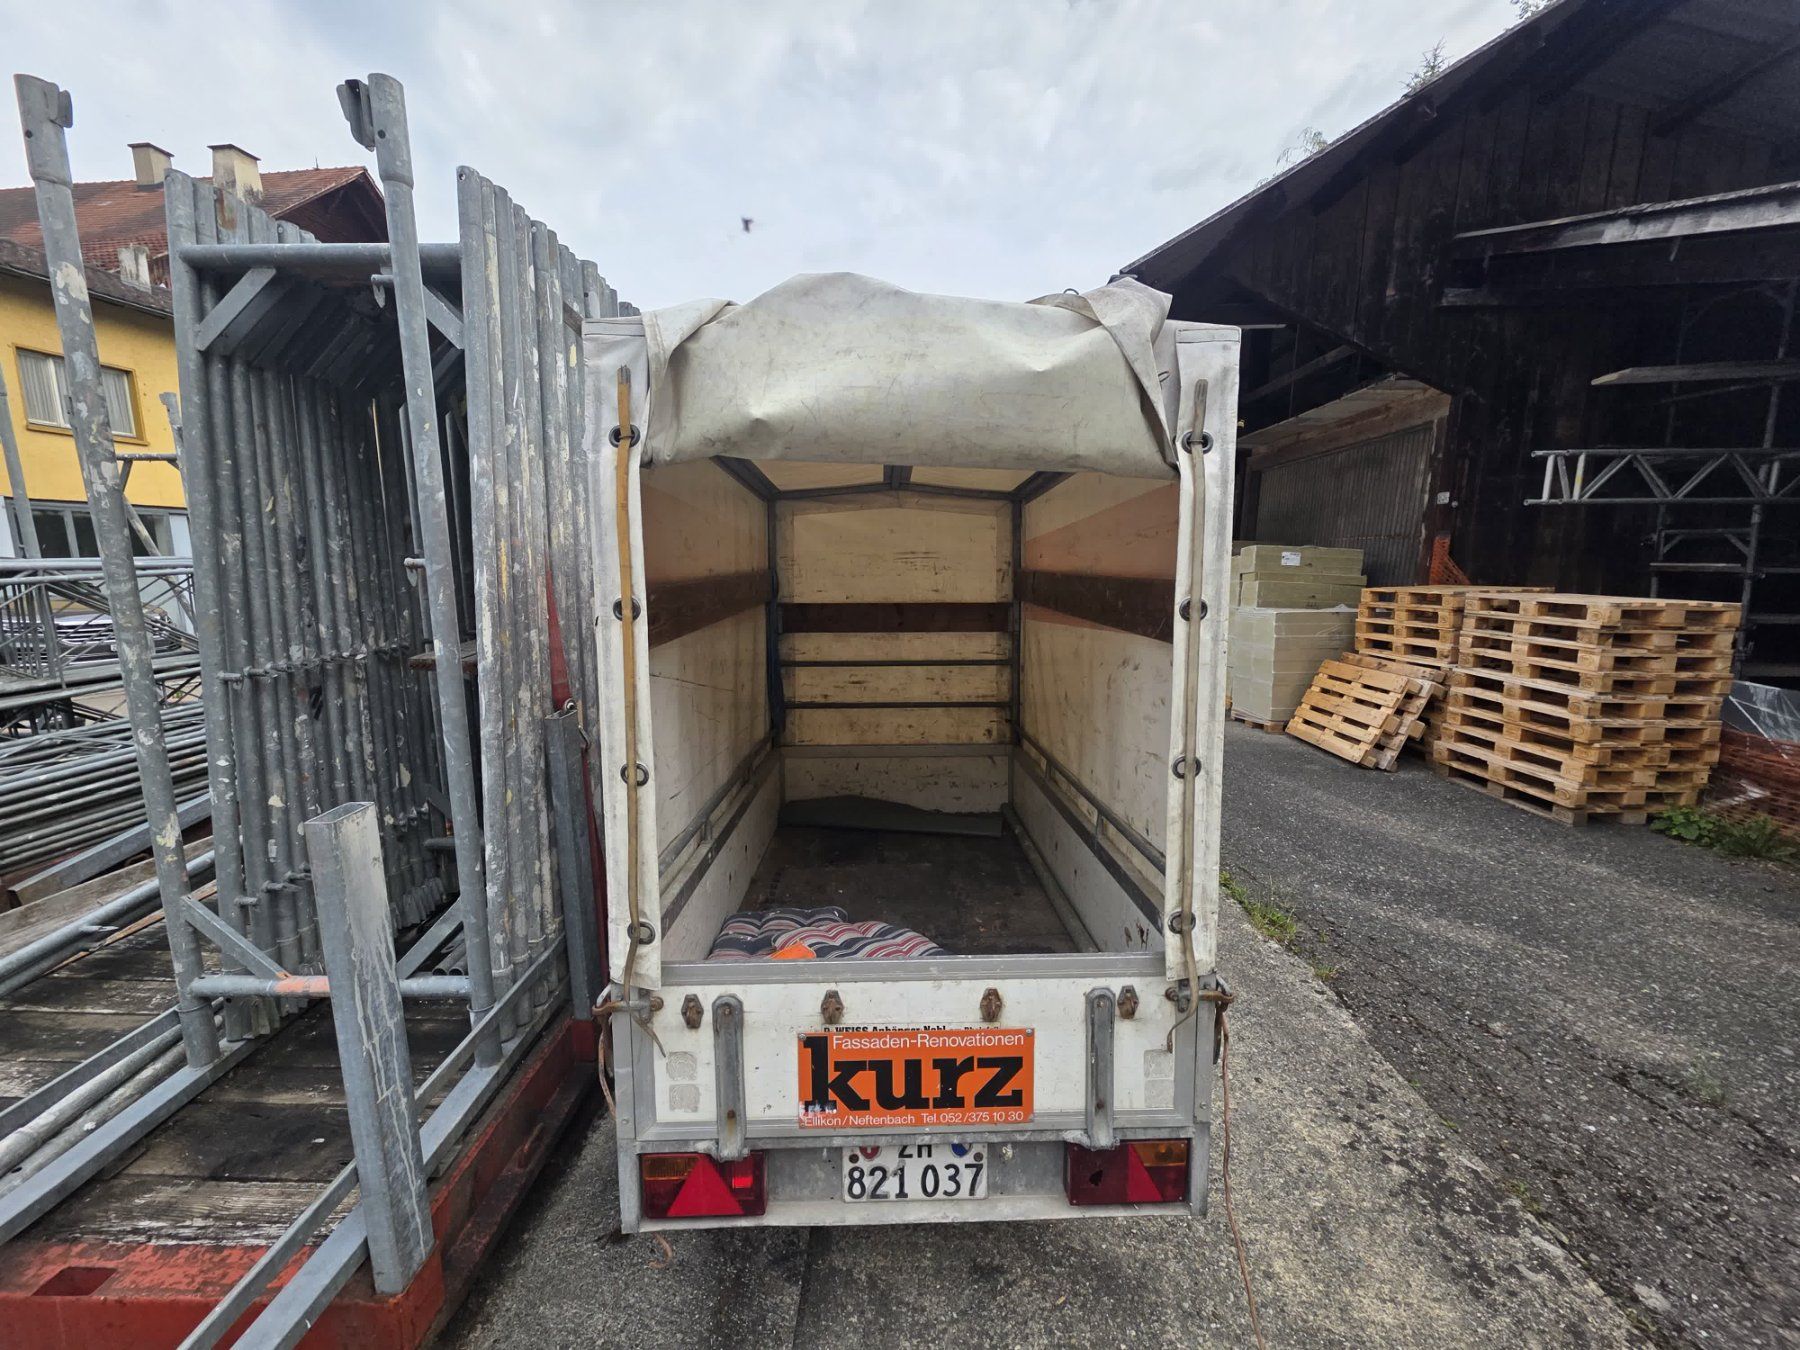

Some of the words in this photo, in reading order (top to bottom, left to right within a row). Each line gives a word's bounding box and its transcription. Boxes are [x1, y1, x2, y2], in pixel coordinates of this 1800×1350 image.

[833, 1033, 1024, 1049] Fassaden-Renovationen
[803, 1036, 1024, 1111] kurz
[993, 1111, 1005, 1121] 10
[1008, 1111, 1023, 1121] 30
